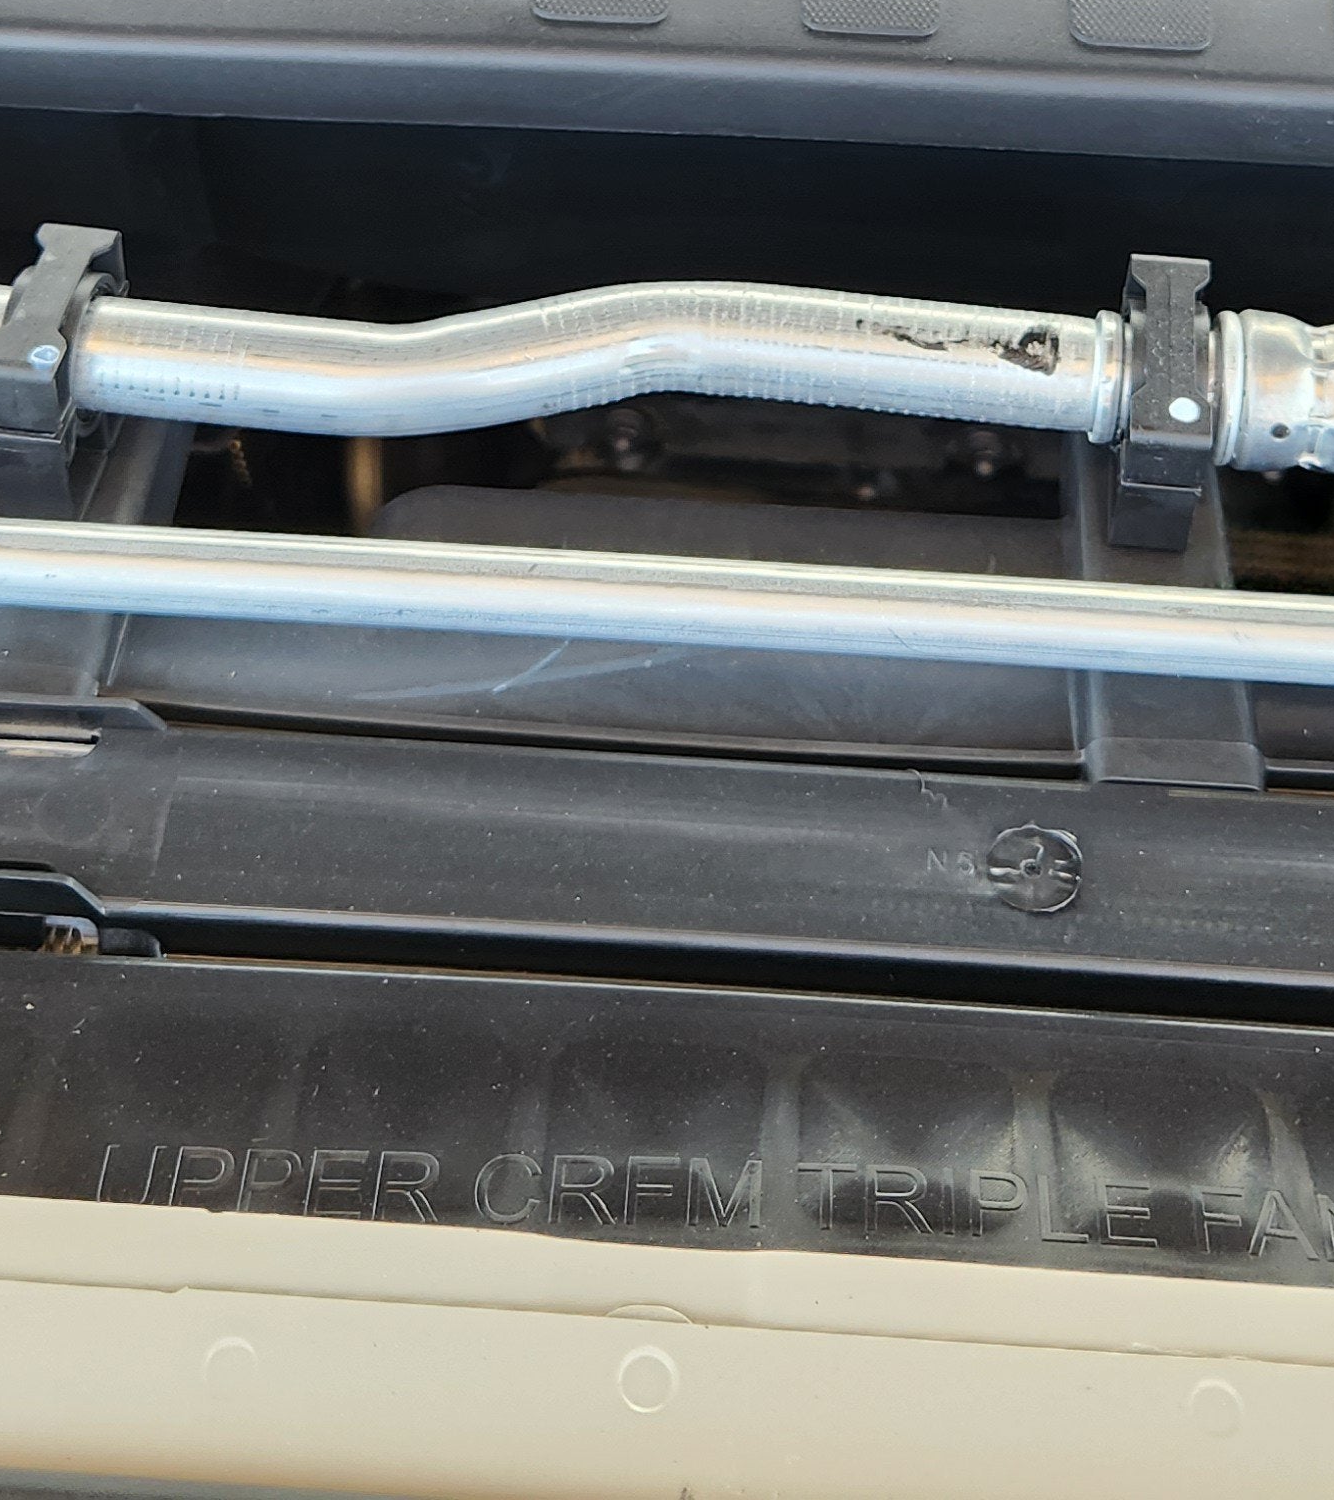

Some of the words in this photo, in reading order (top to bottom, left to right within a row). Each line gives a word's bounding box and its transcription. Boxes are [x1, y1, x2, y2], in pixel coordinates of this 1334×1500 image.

[96, 1144, 440, 1222] UPPER
[474, 1153, 763, 1228] CRFM
[797, 1161, 1158, 1248] TRIPLE
